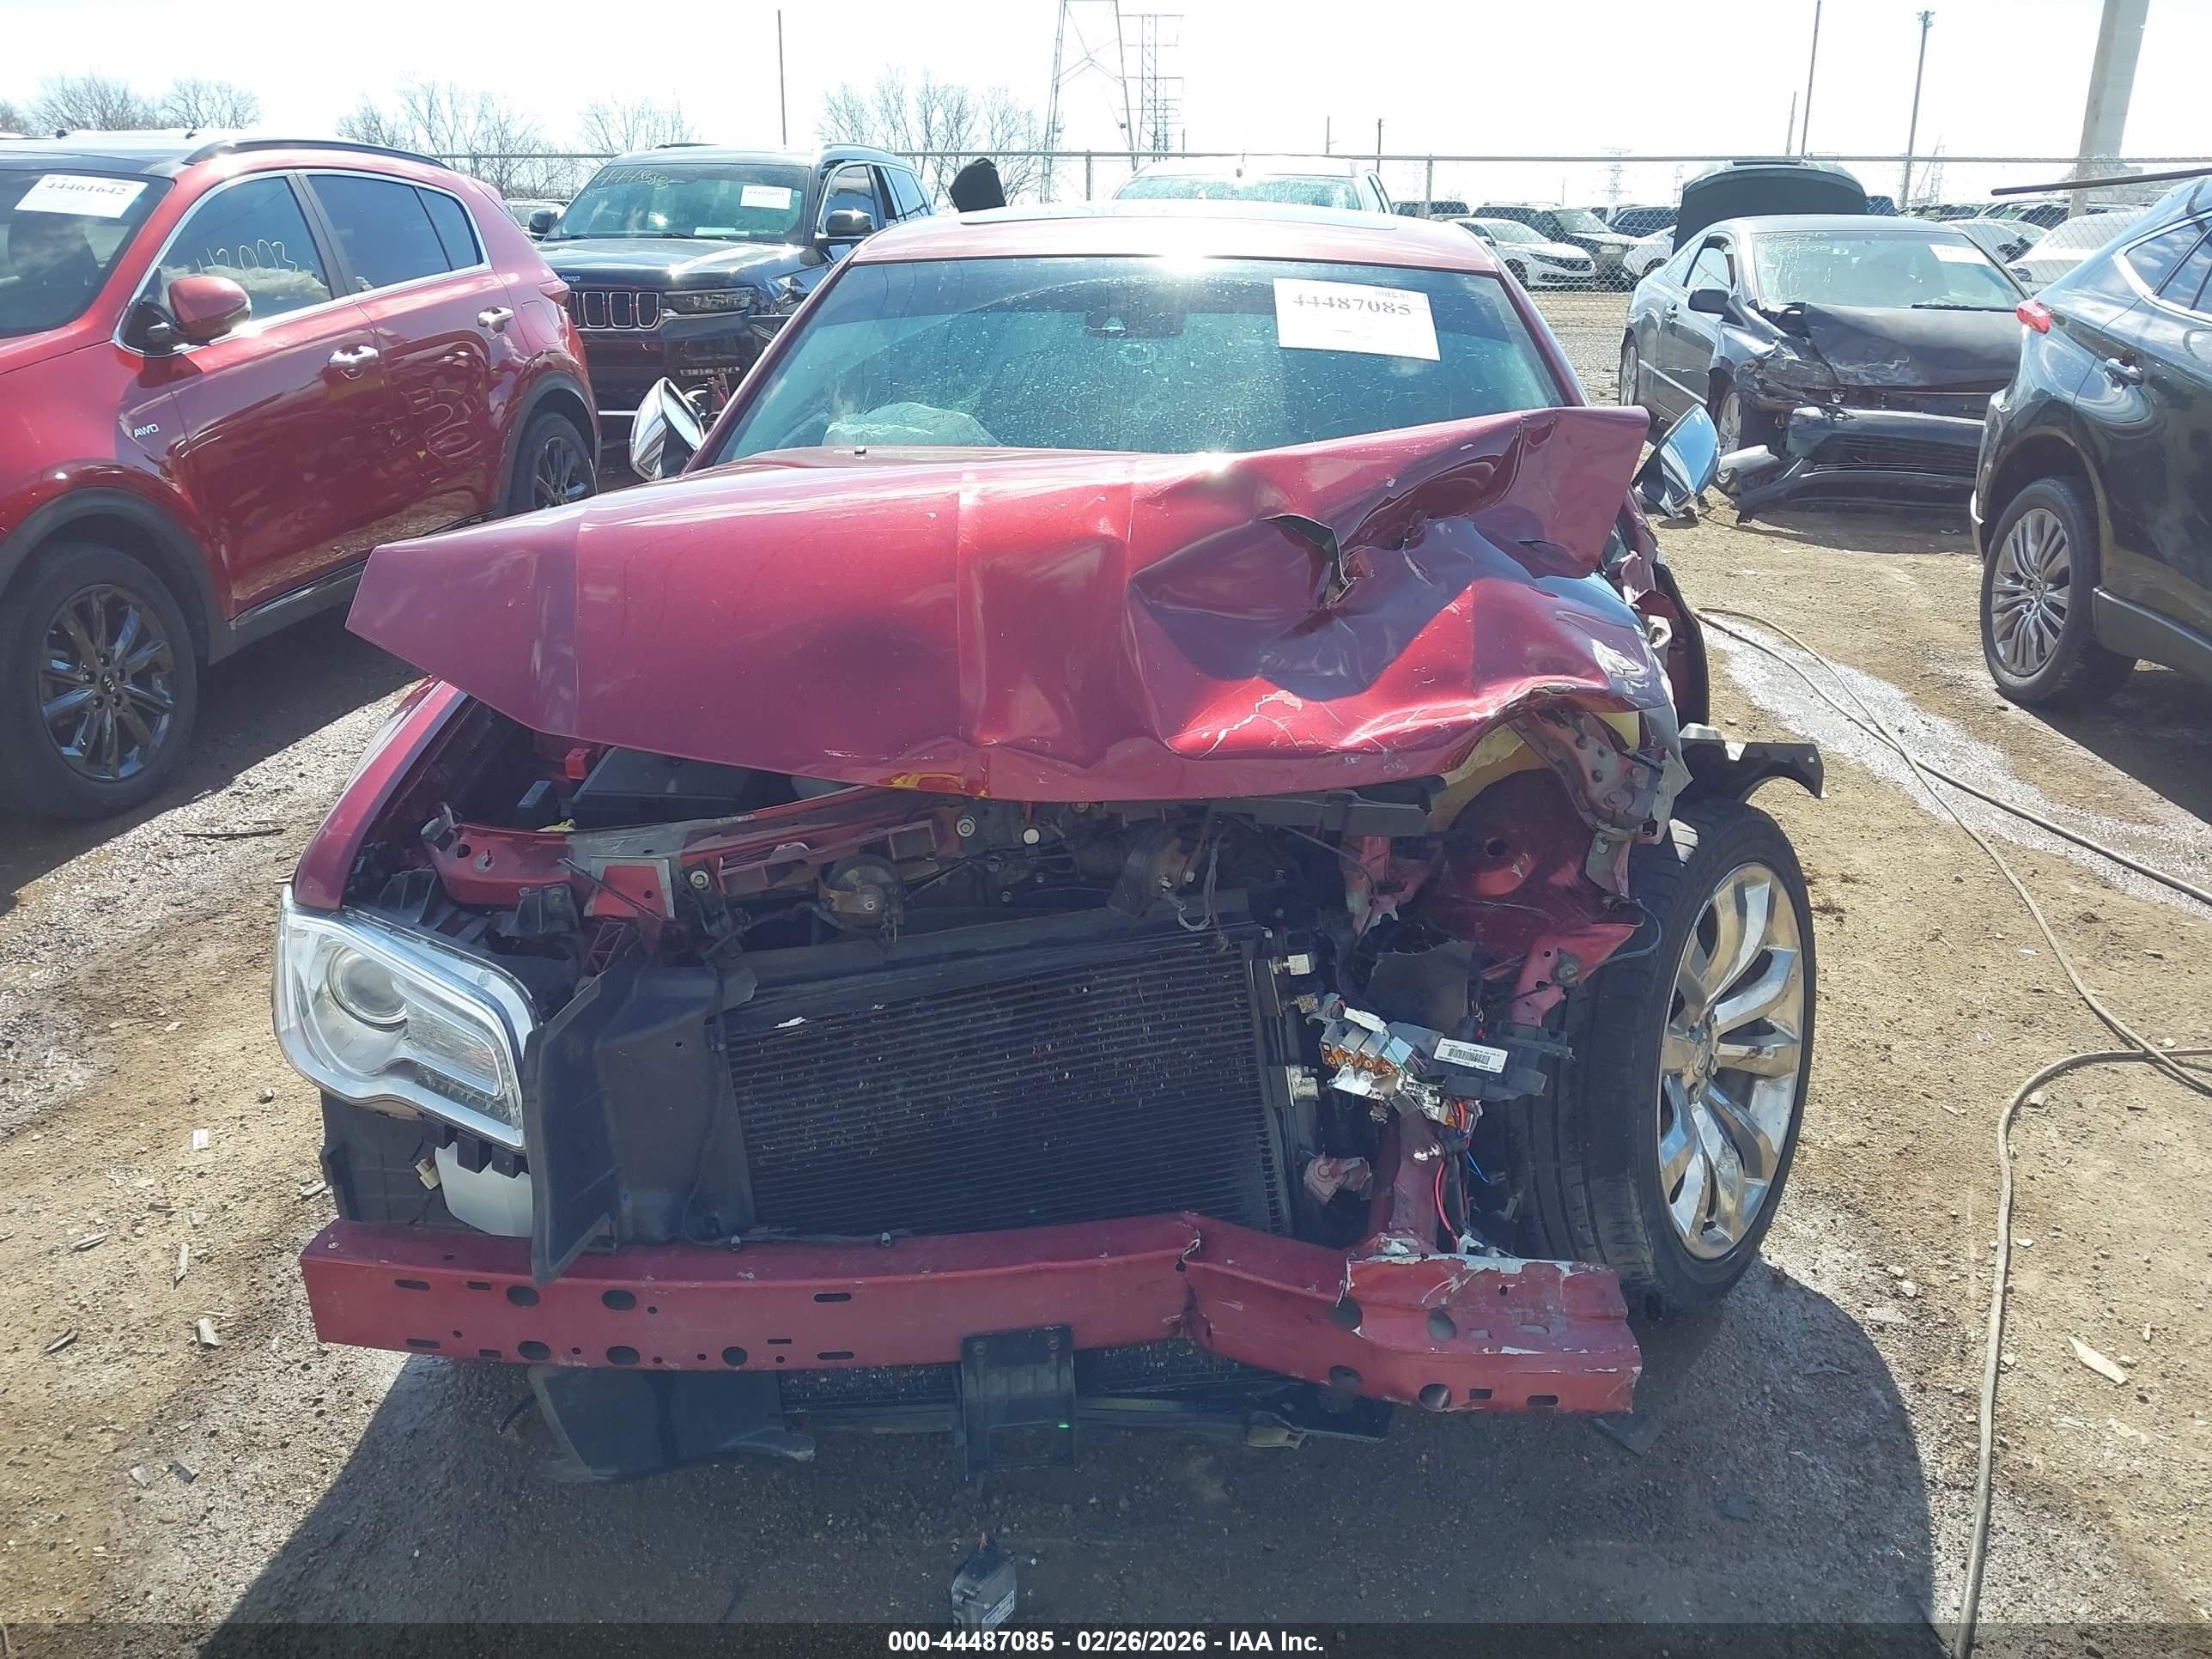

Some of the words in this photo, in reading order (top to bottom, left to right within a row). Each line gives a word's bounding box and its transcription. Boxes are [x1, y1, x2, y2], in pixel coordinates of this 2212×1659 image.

[45, 181, 127, 196] 44461642
[1291, 294, 1413, 316] 44487085
[133, 423, 160, 438] AWD
